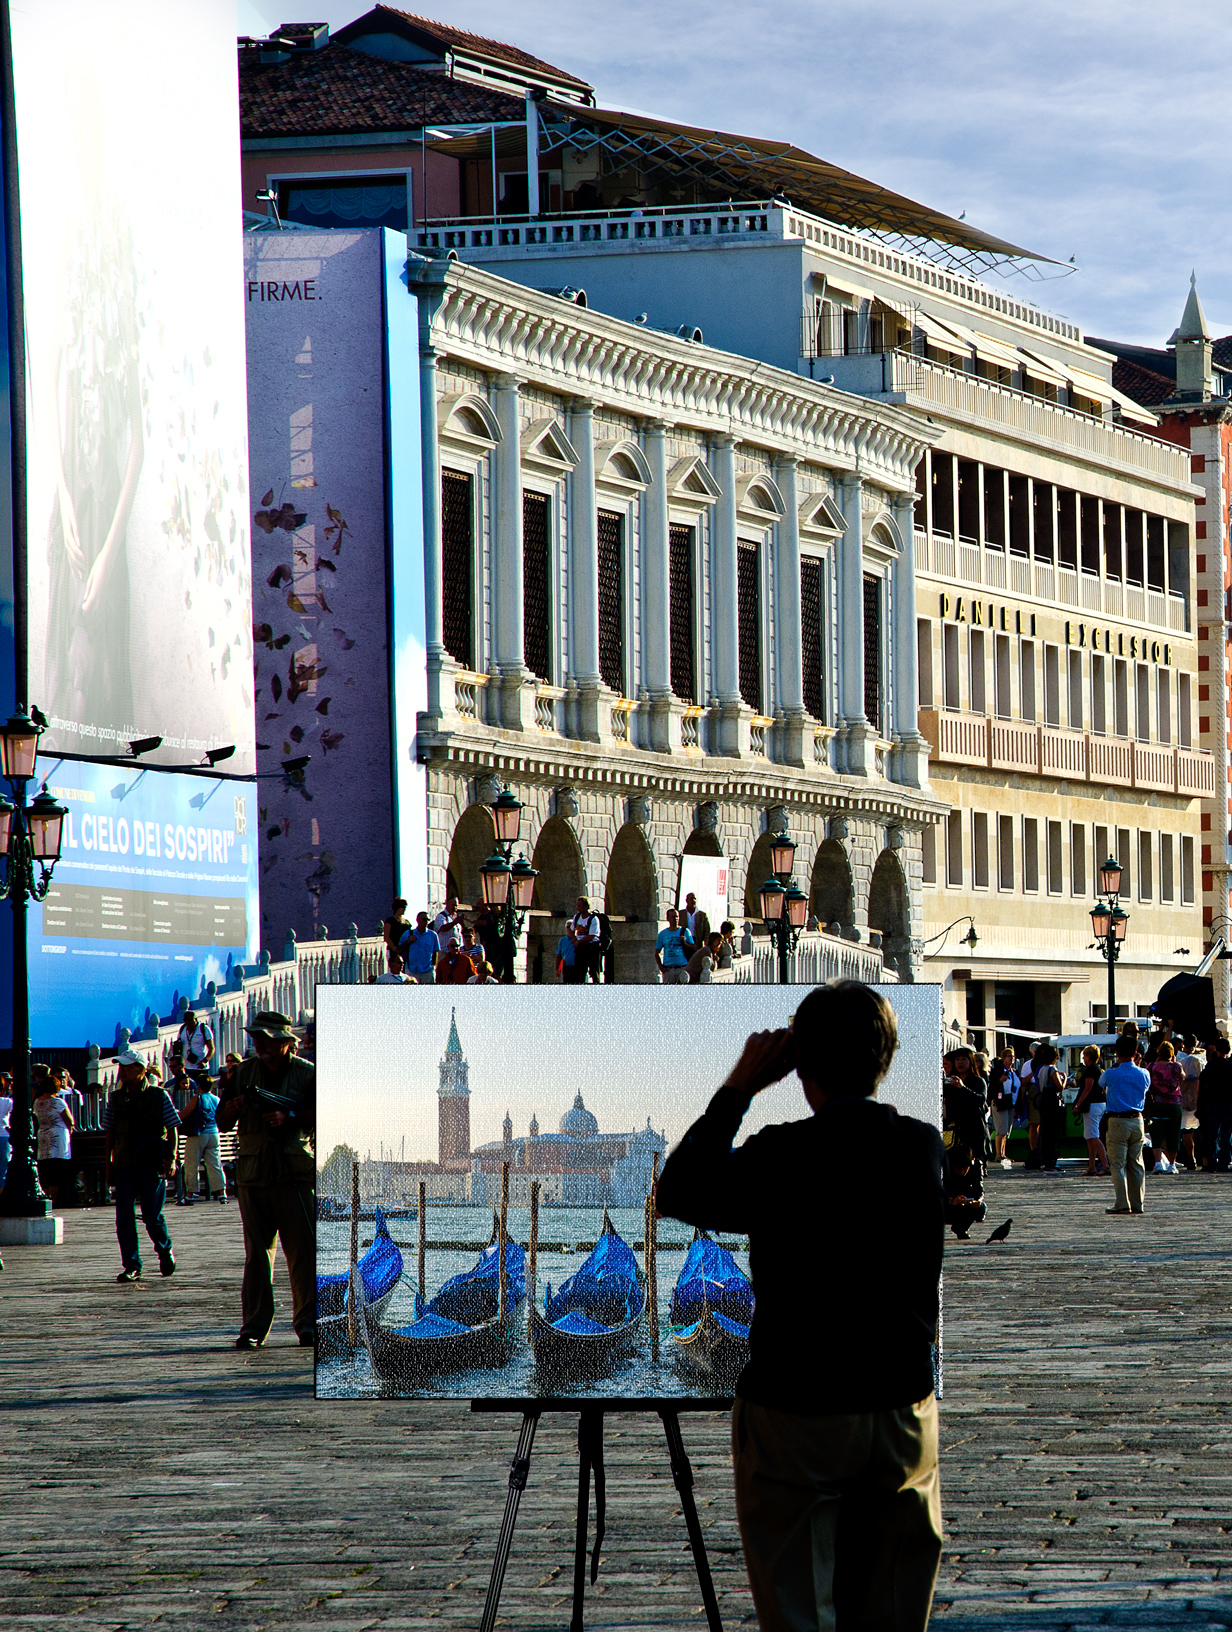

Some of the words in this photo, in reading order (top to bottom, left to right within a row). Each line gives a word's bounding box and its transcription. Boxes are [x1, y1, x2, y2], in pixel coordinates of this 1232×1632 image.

[248, 280, 323, 302] FIRME.
[939, 592, 1037, 637] DANIELI
[1065, 620, 1174, 666] EXCELSIOR
[81, 812, 130, 855] CIELO
[132, 819, 162, 858] DEI
